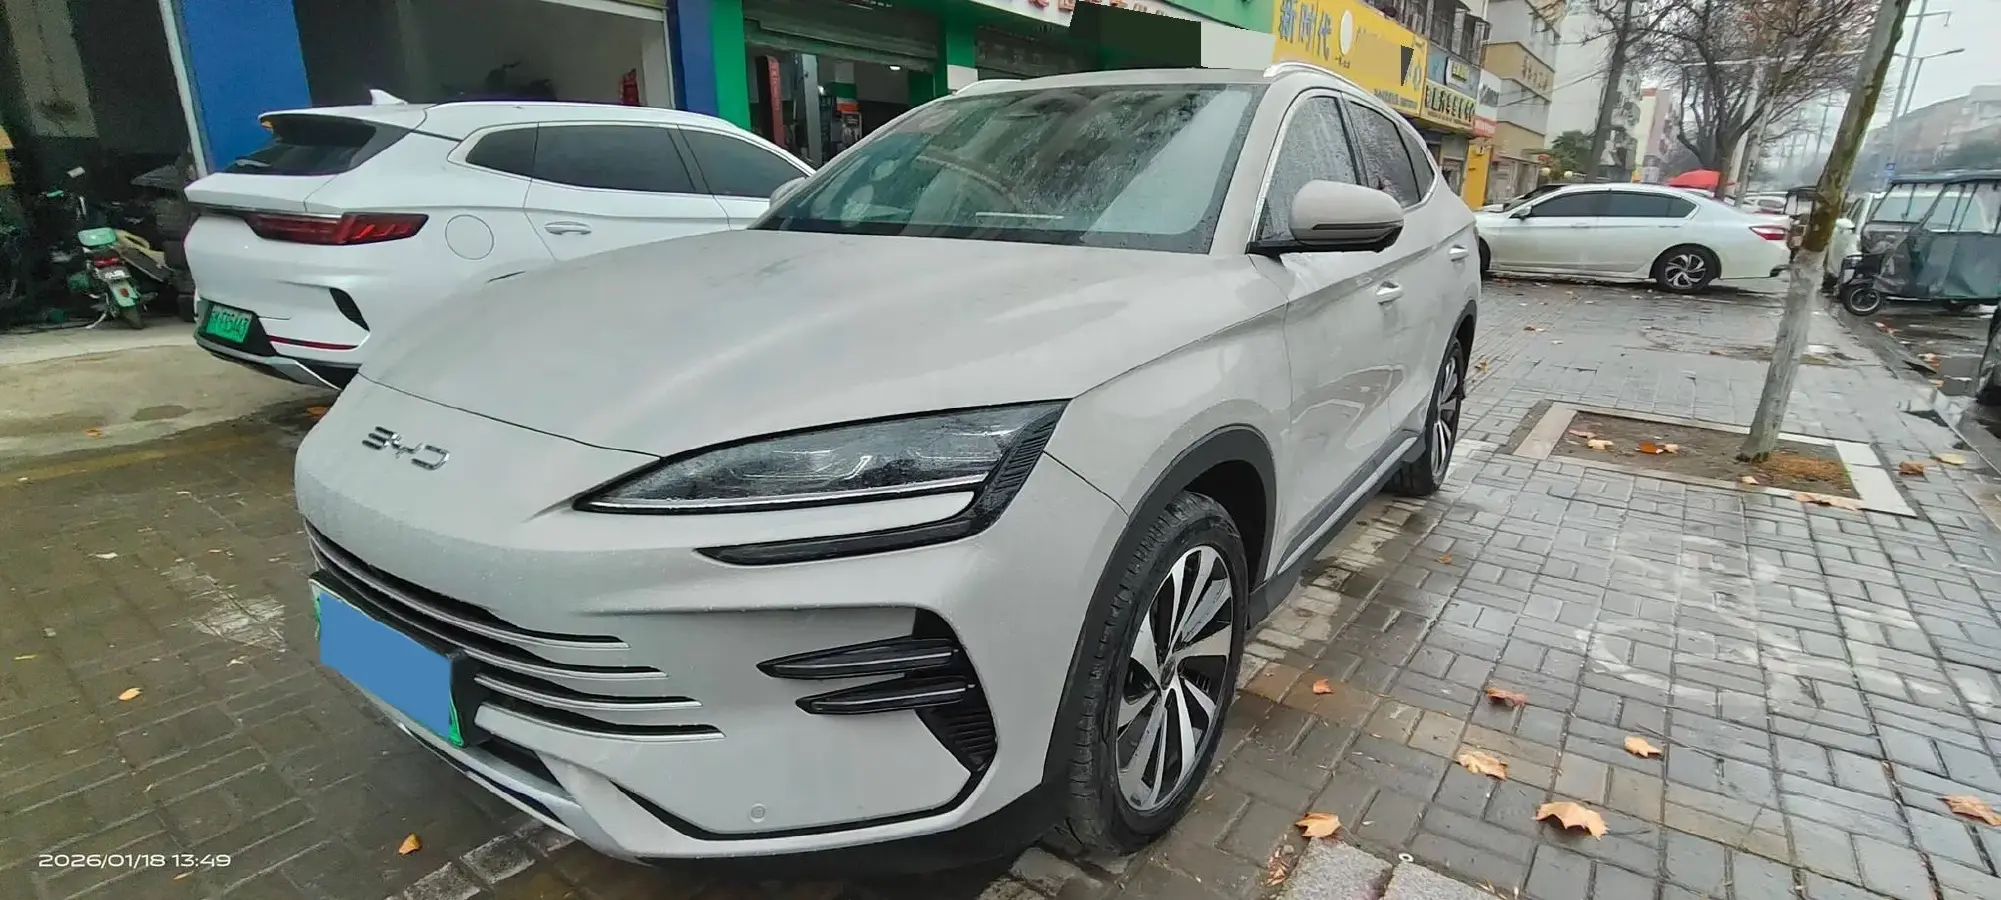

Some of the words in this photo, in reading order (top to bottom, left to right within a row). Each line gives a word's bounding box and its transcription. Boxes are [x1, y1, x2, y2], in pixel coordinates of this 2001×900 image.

[1279, 0, 1332, 61] 新时代
[362, 426, 450, 470] BYD
